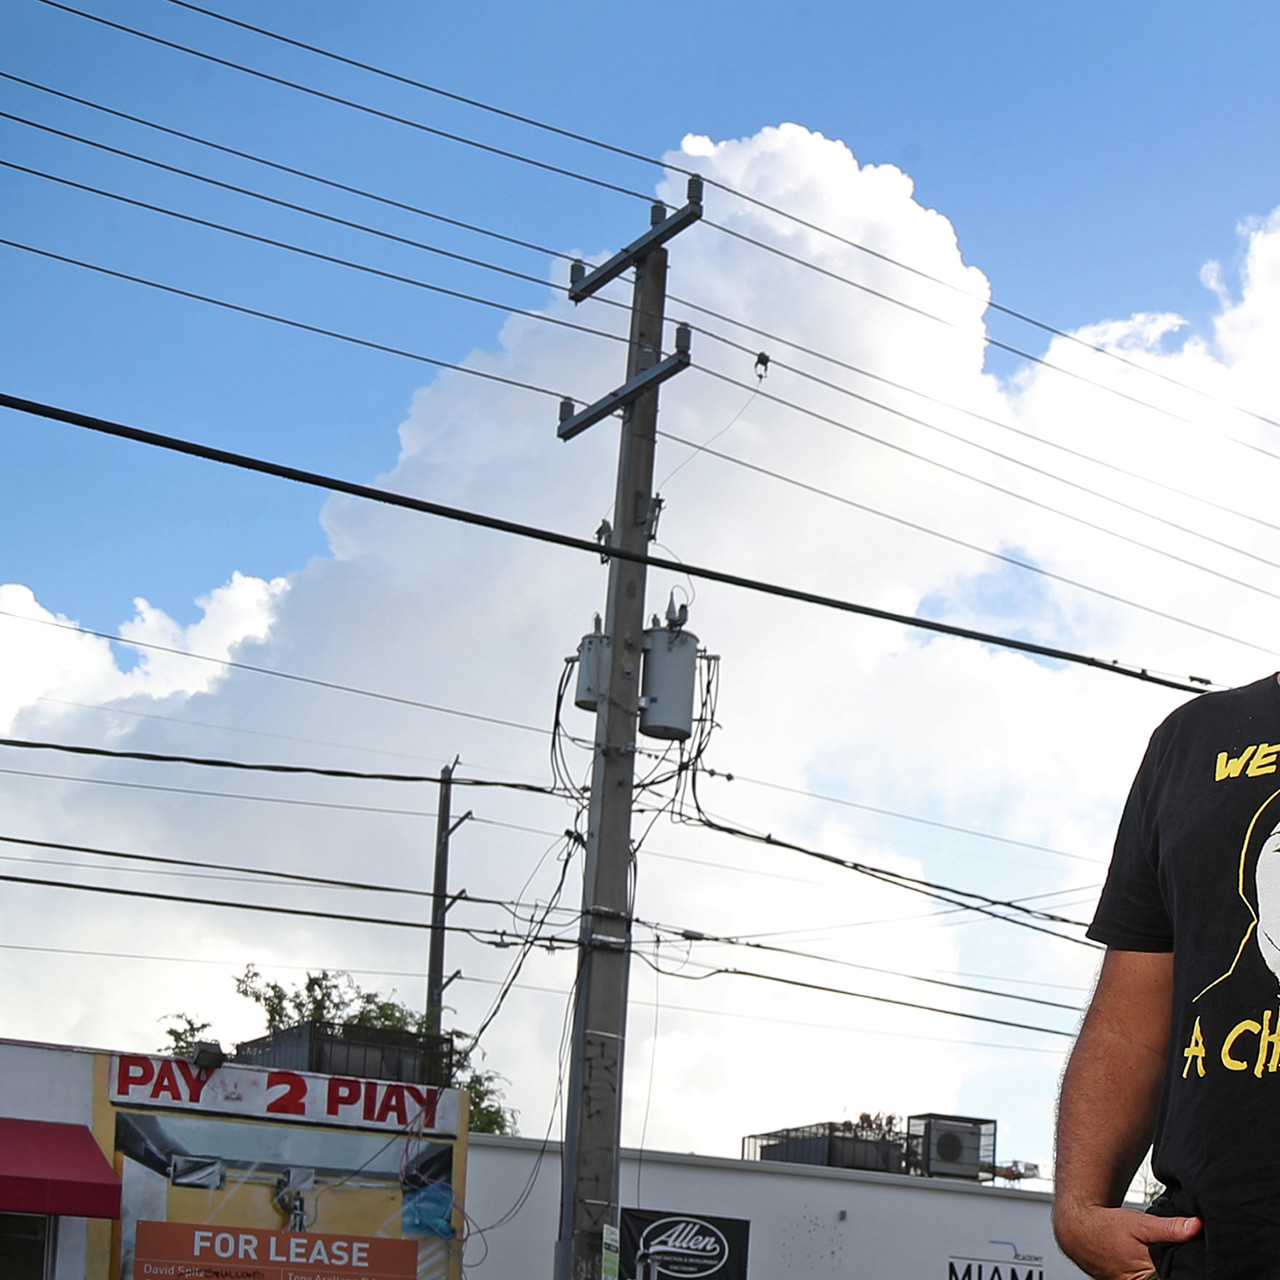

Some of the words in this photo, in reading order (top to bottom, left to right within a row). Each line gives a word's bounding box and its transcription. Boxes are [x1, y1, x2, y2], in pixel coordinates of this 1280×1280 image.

[1182, 1016, 1206, 1078] A
[117, 1055, 217, 1103] PAY
[266, 1070, 308, 1115] 2
[193, 1230, 258, 1260] FOR
[269, 1236, 370, 1268] LEASE
[650, 1222, 719, 1252] Allen
[144, 1264, 174, 1275] David
